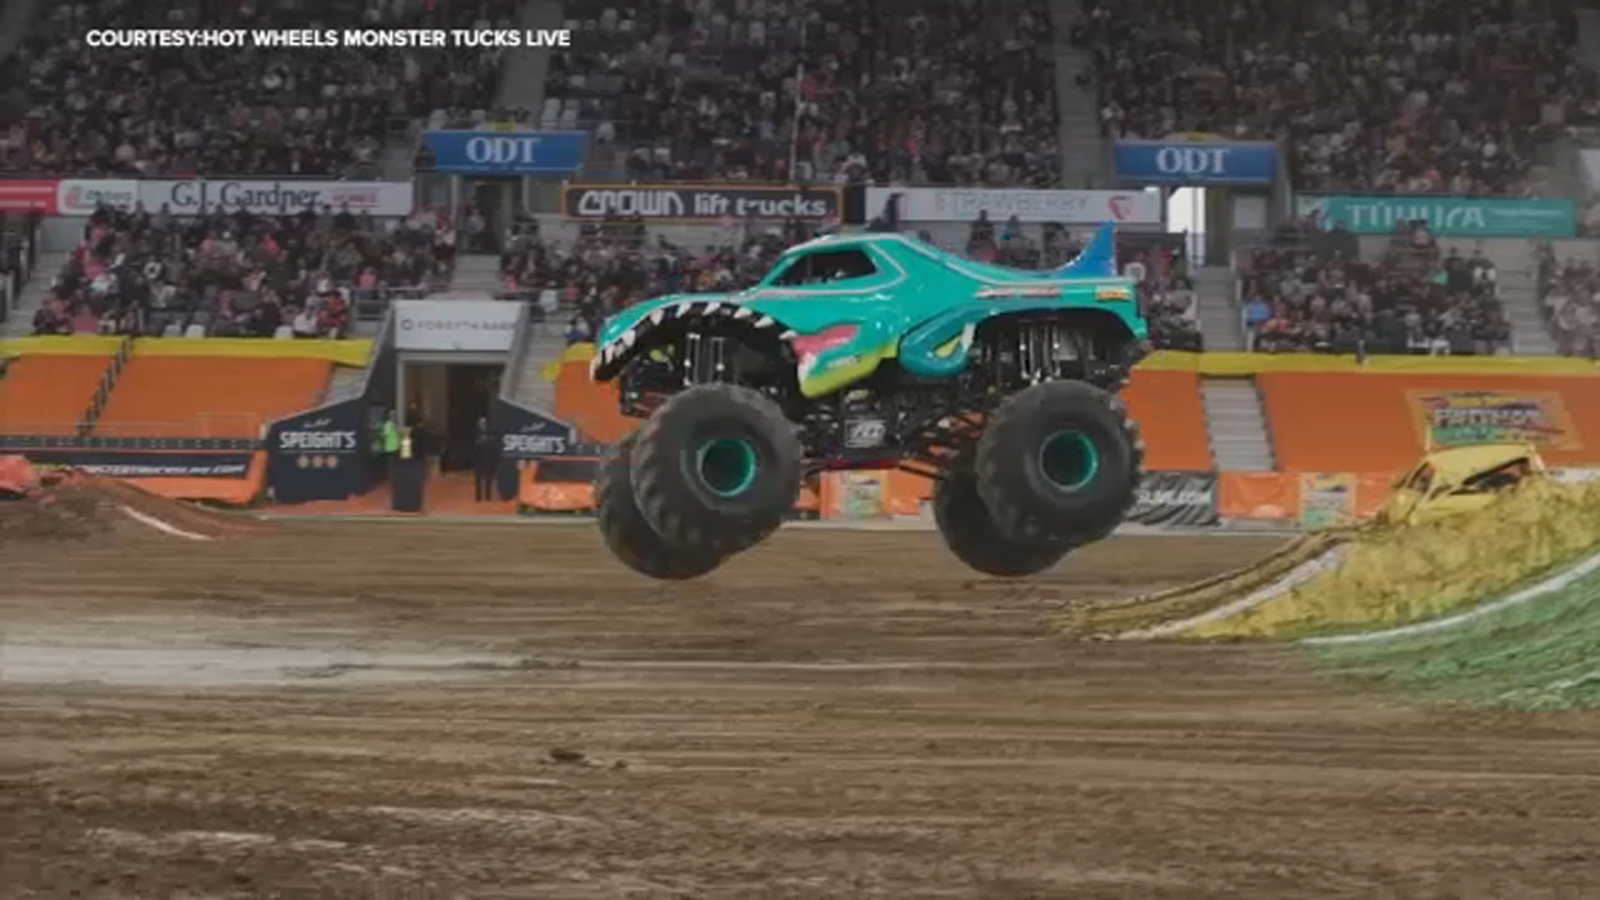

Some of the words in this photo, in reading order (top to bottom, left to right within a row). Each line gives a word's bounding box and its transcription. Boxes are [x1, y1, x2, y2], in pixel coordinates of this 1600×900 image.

[464, 136, 539, 164] ODT
[1155, 147, 1230, 174] ODT
[694, 193, 729, 215] lift
[735, 193, 827, 217] trucks
[280, 431, 356, 449] SPEIGHT'S
